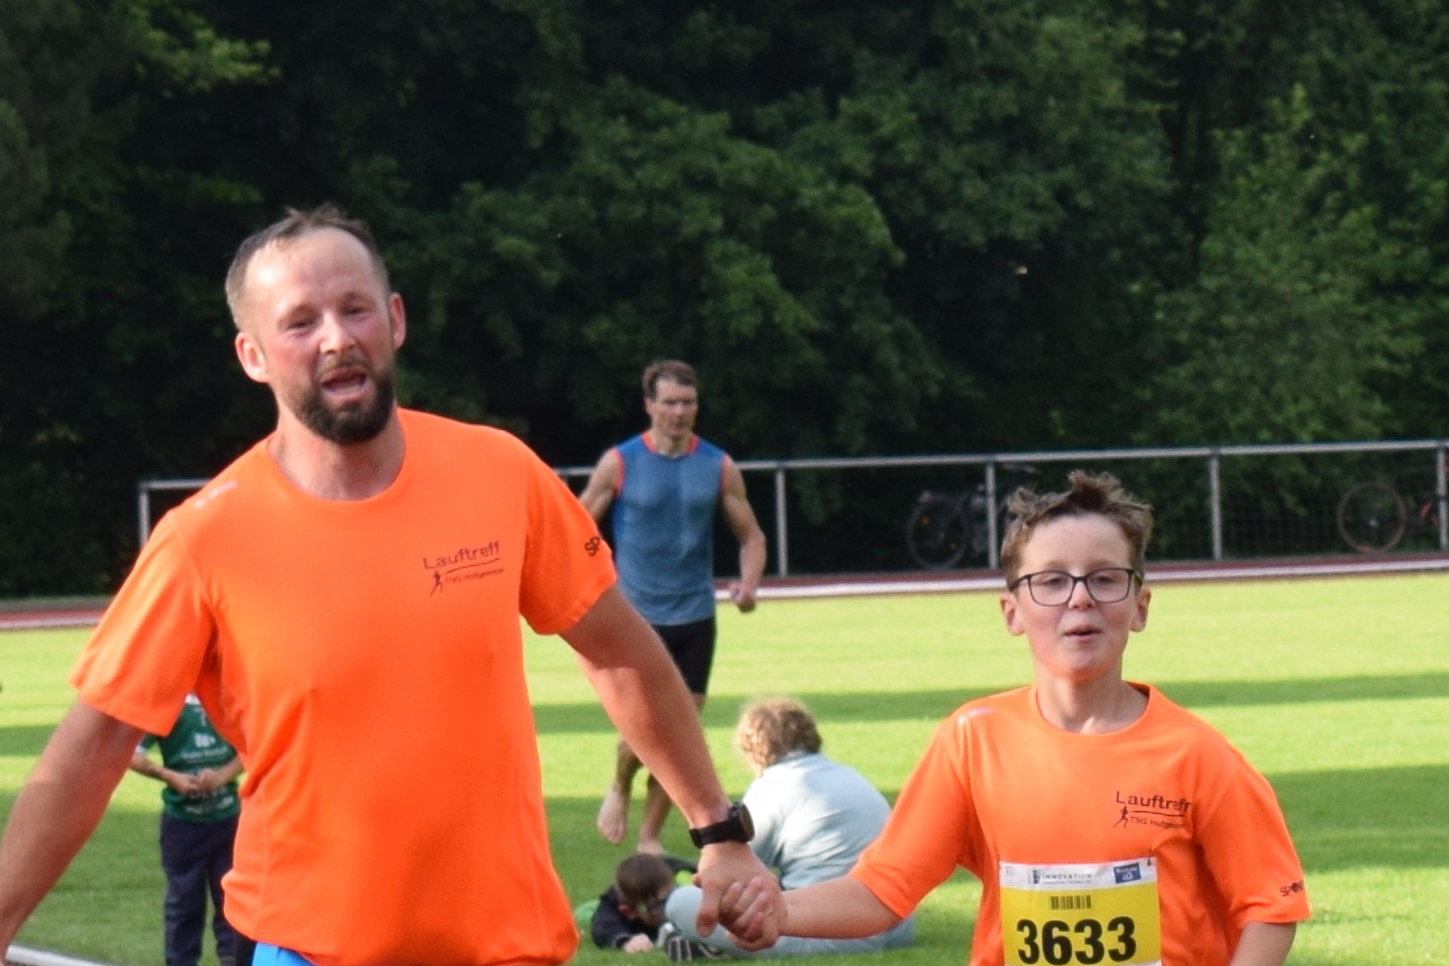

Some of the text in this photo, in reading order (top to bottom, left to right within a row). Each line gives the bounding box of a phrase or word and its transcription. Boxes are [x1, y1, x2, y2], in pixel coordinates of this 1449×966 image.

[422, 541, 500, 570] Lauftreff
[1116, 791, 1191, 812] Lauftreff
[1016, 917, 1137, 966] 3633
